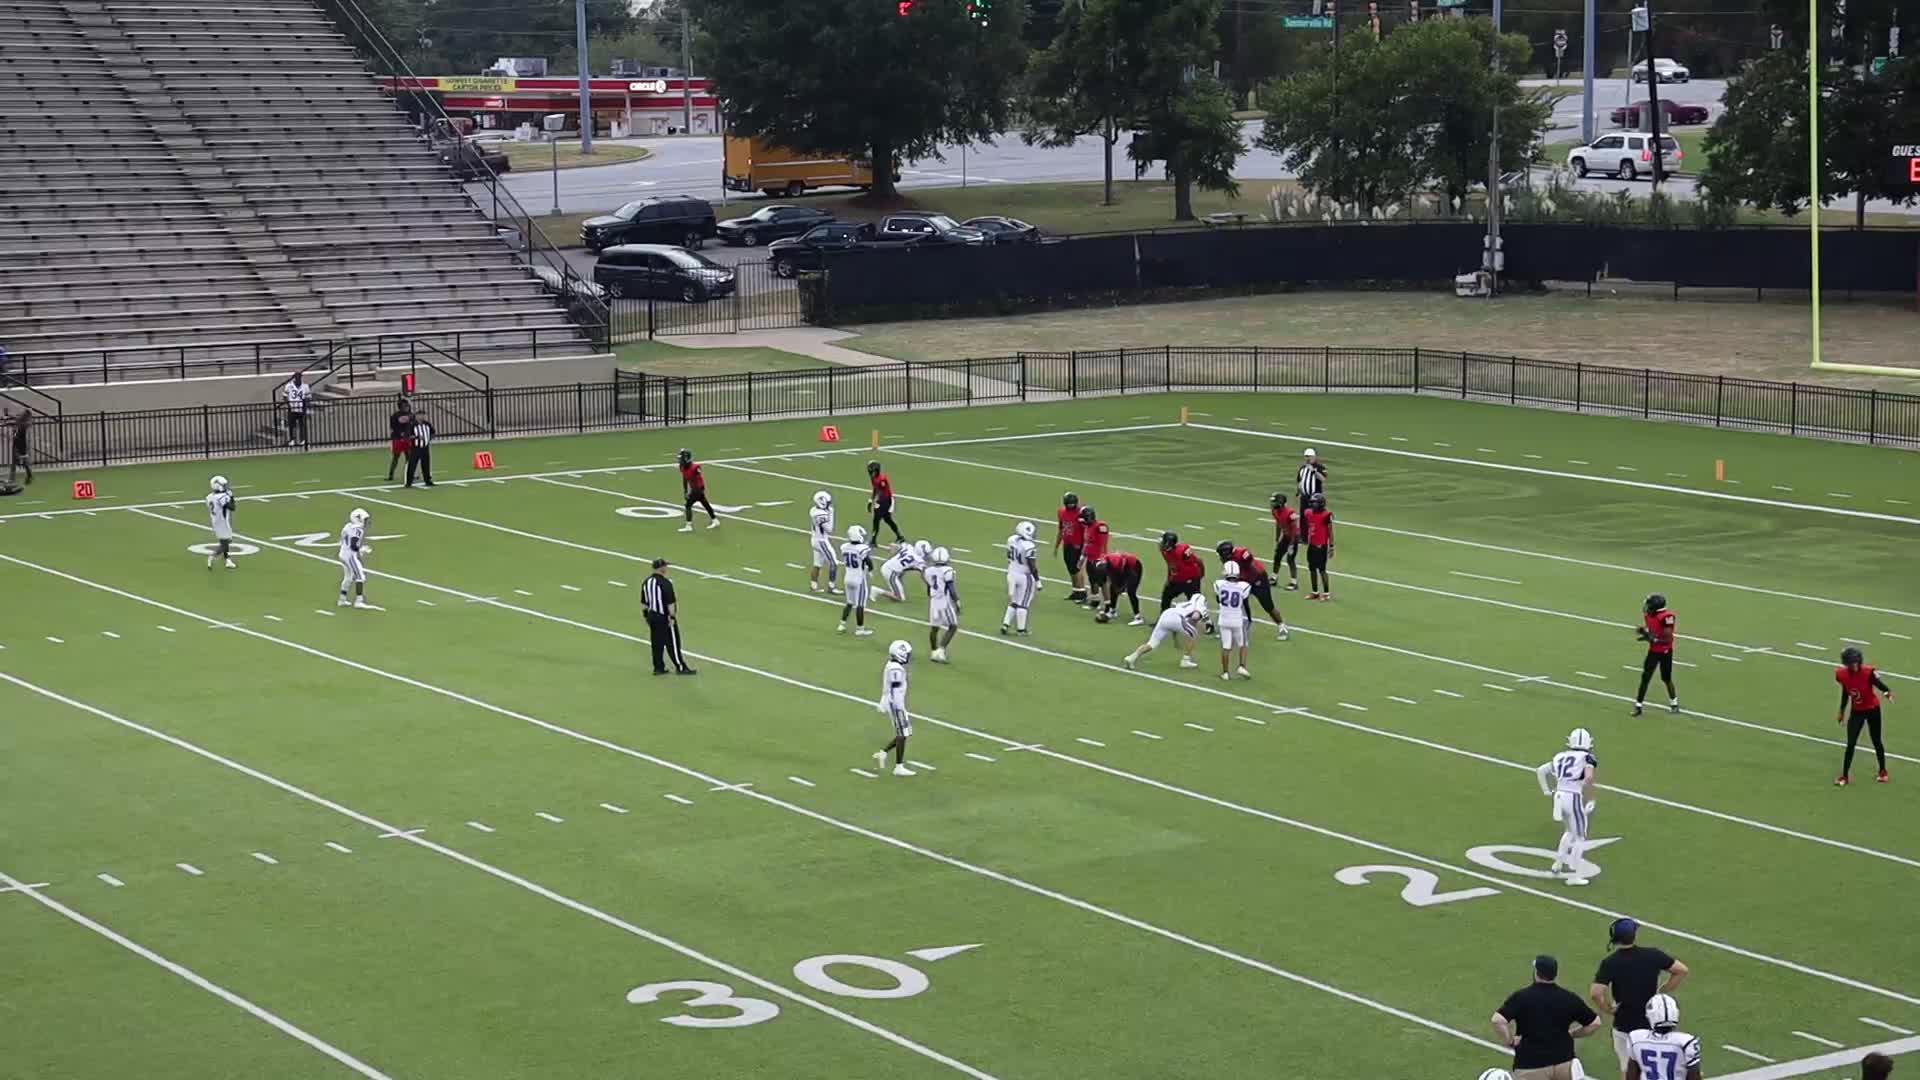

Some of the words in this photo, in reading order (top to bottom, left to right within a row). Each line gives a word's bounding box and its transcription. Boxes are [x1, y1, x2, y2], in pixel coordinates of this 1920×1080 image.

[826, 427, 837, 441] G
[479, 453, 492, 467] 10
[76, 482, 93, 497] 20
[1557, 755, 1576, 778] 12
[1640, 1048, 1679, 1080] 57
